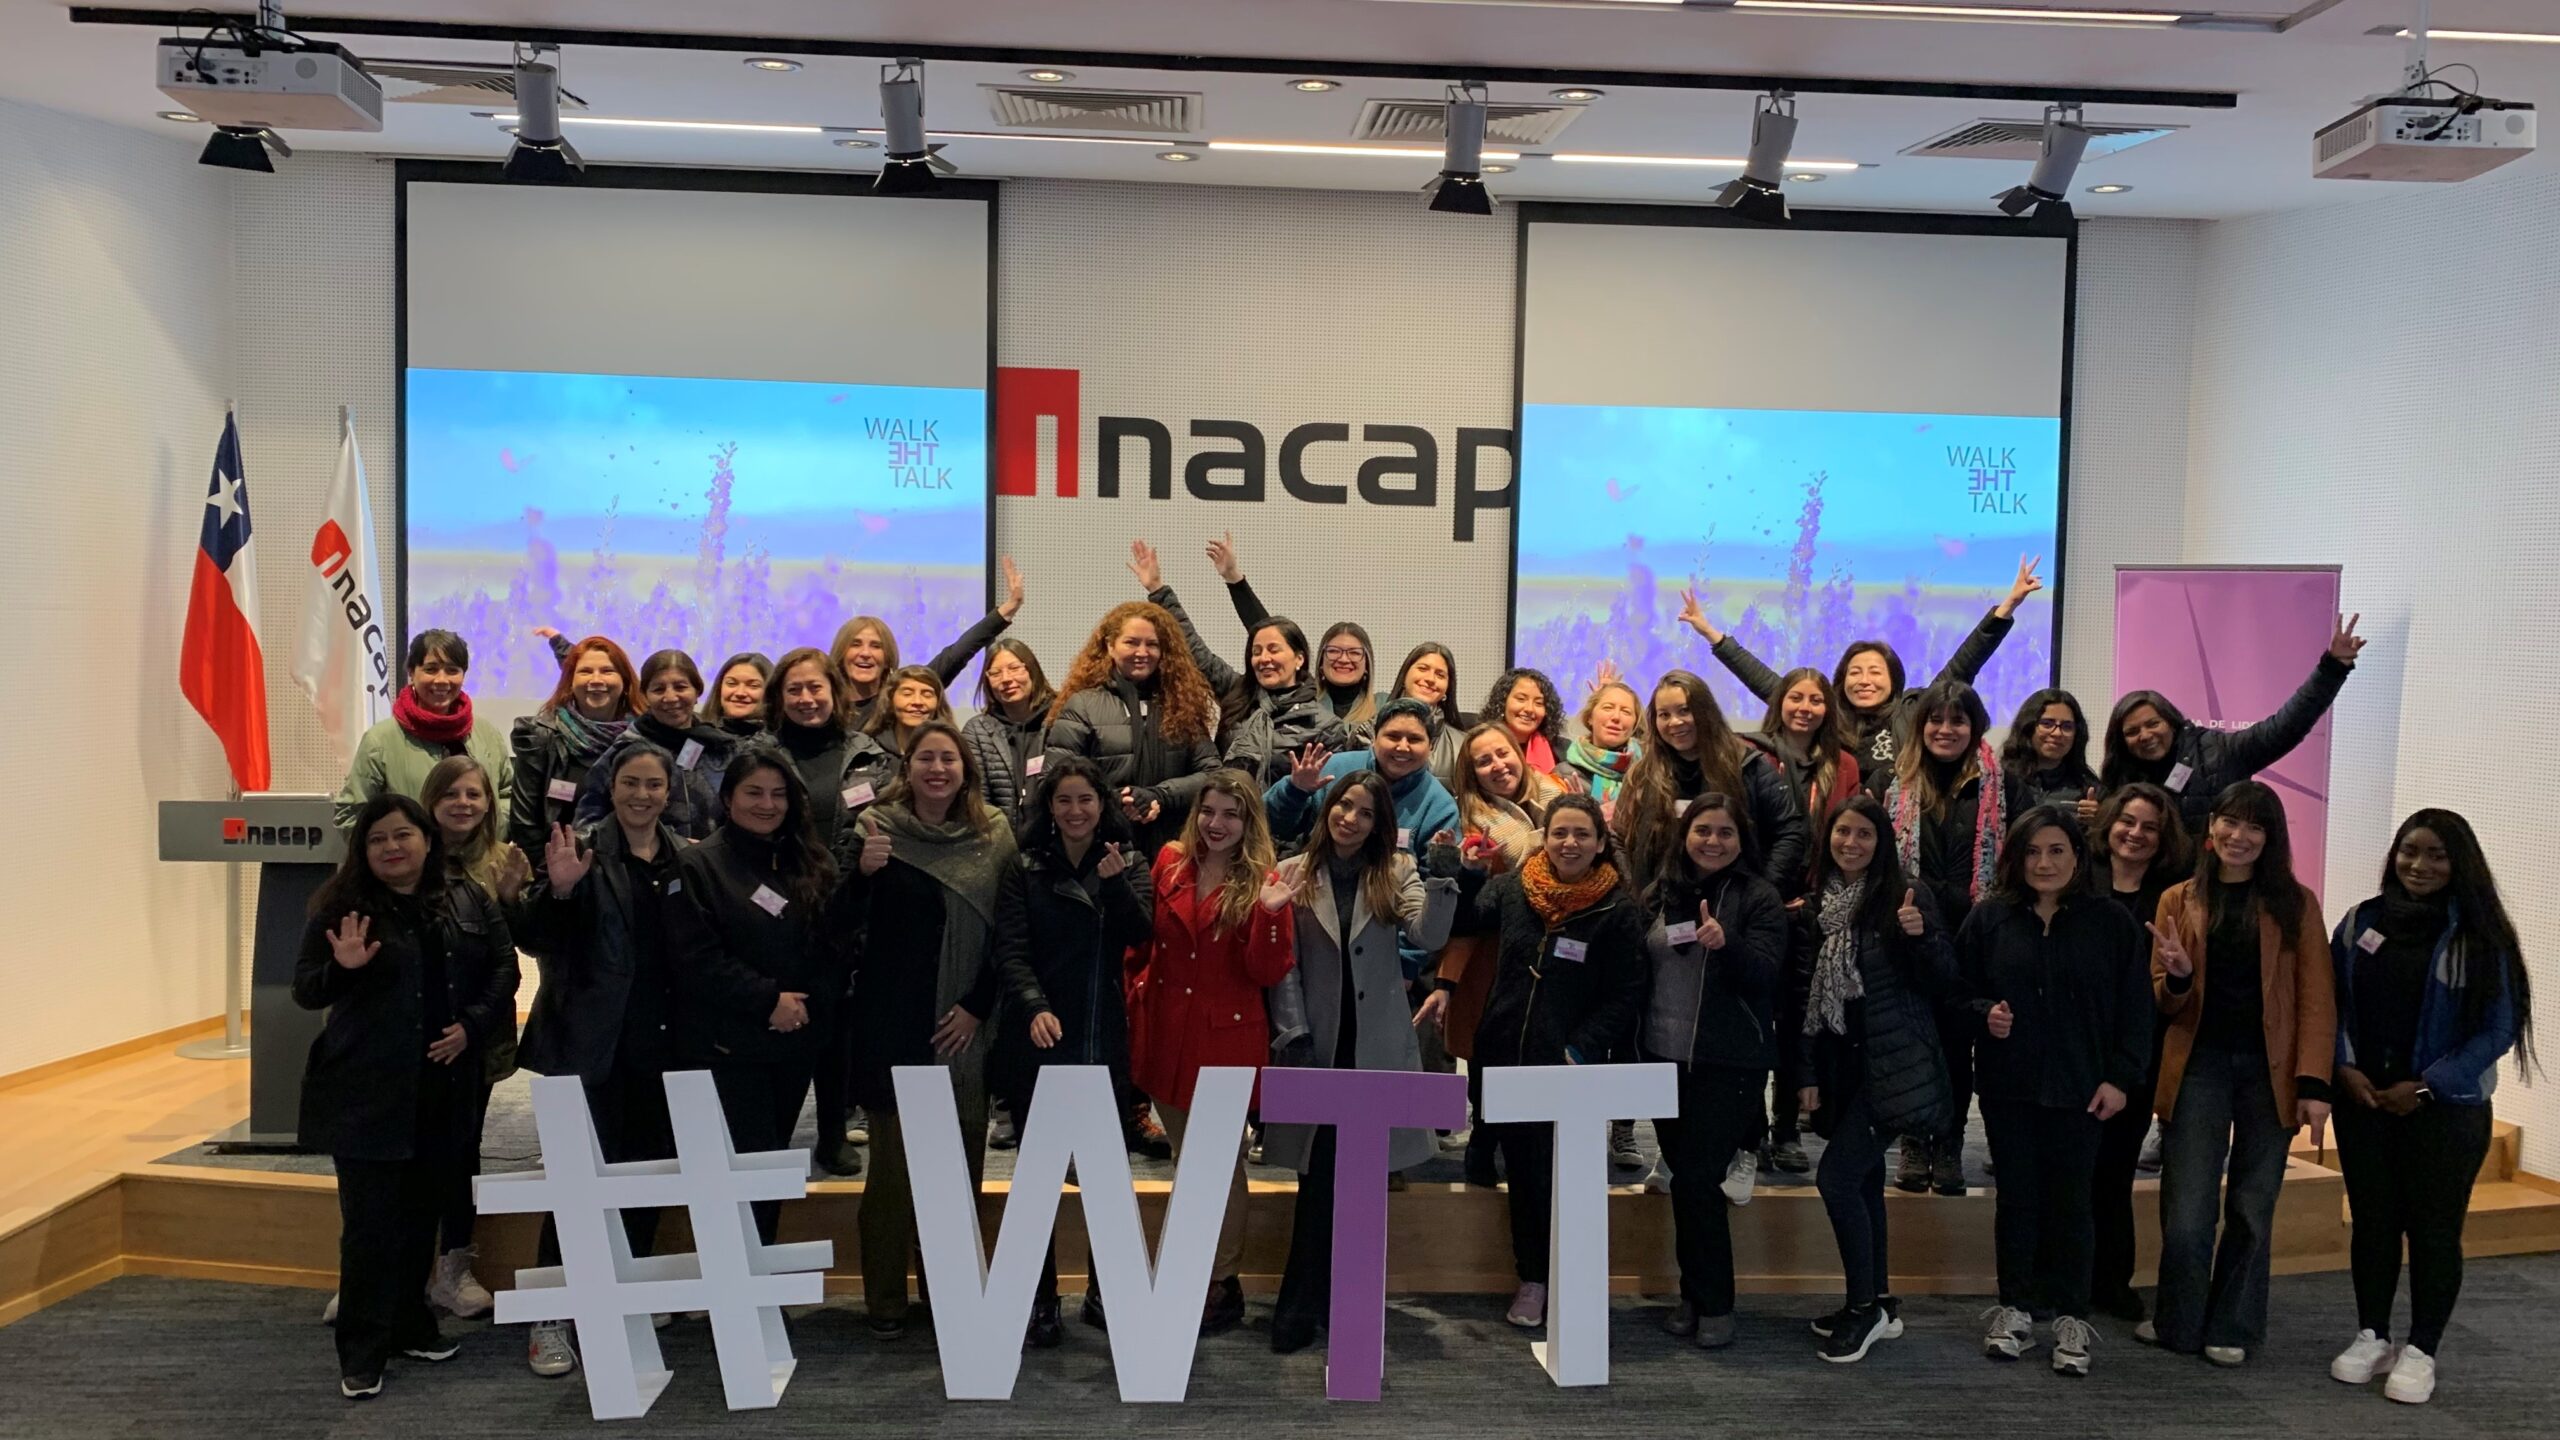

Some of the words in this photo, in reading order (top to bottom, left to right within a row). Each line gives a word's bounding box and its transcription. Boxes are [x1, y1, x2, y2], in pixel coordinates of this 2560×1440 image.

[863, 416, 939, 442] WALK
[1947, 445, 2016, 469] WALK
[888, 465, 952, 490] TALK
[1968, 491, 2028, 515] TALK
[2209, 719, 2226, 729] DE
